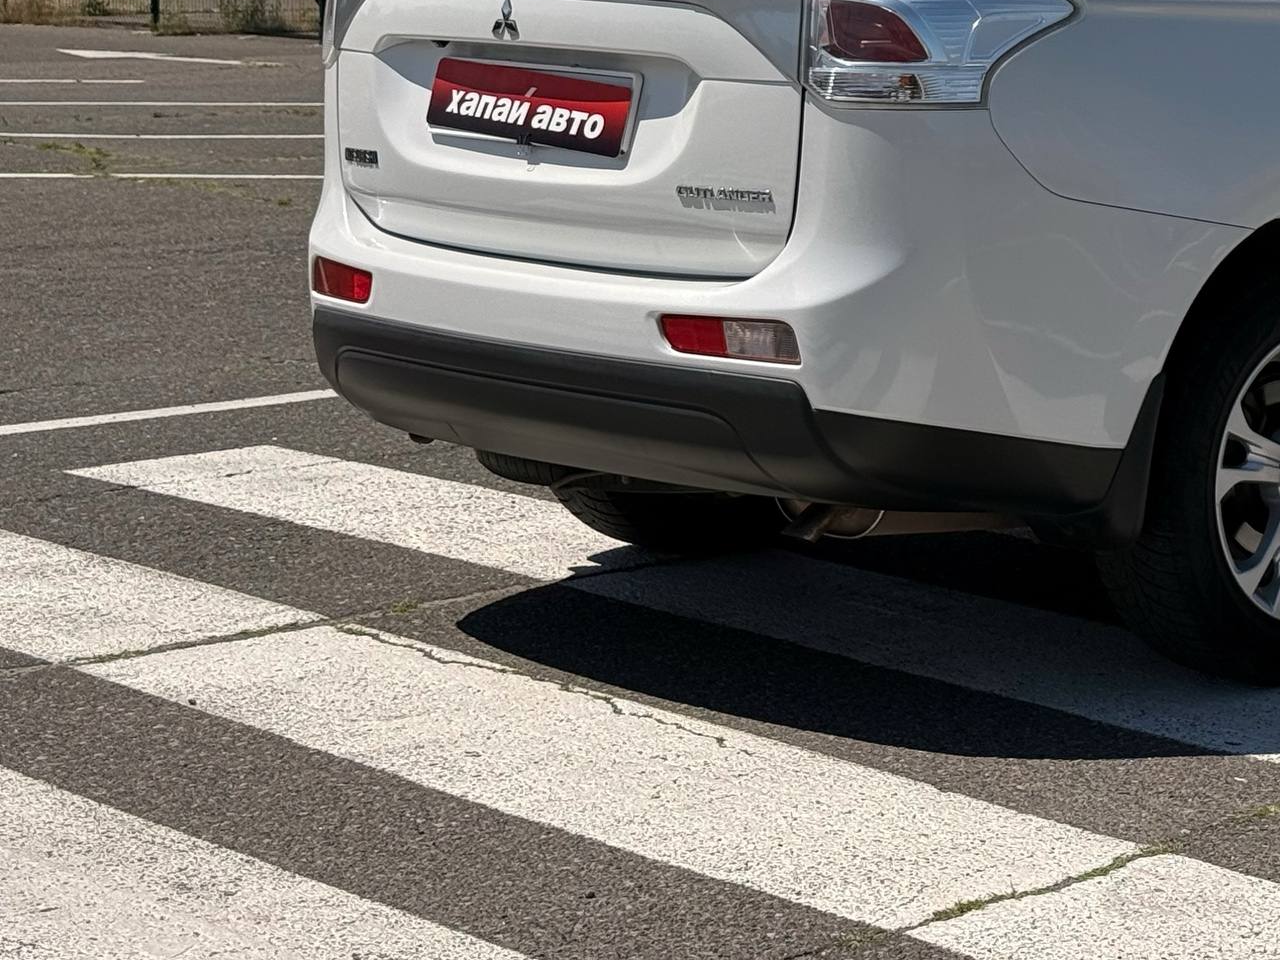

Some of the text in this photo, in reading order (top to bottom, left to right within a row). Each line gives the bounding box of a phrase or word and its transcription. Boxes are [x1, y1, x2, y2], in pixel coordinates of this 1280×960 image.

[445, 87, 605, 140] хапай авто
[676, 185, 773, 204] OUTLANDER
